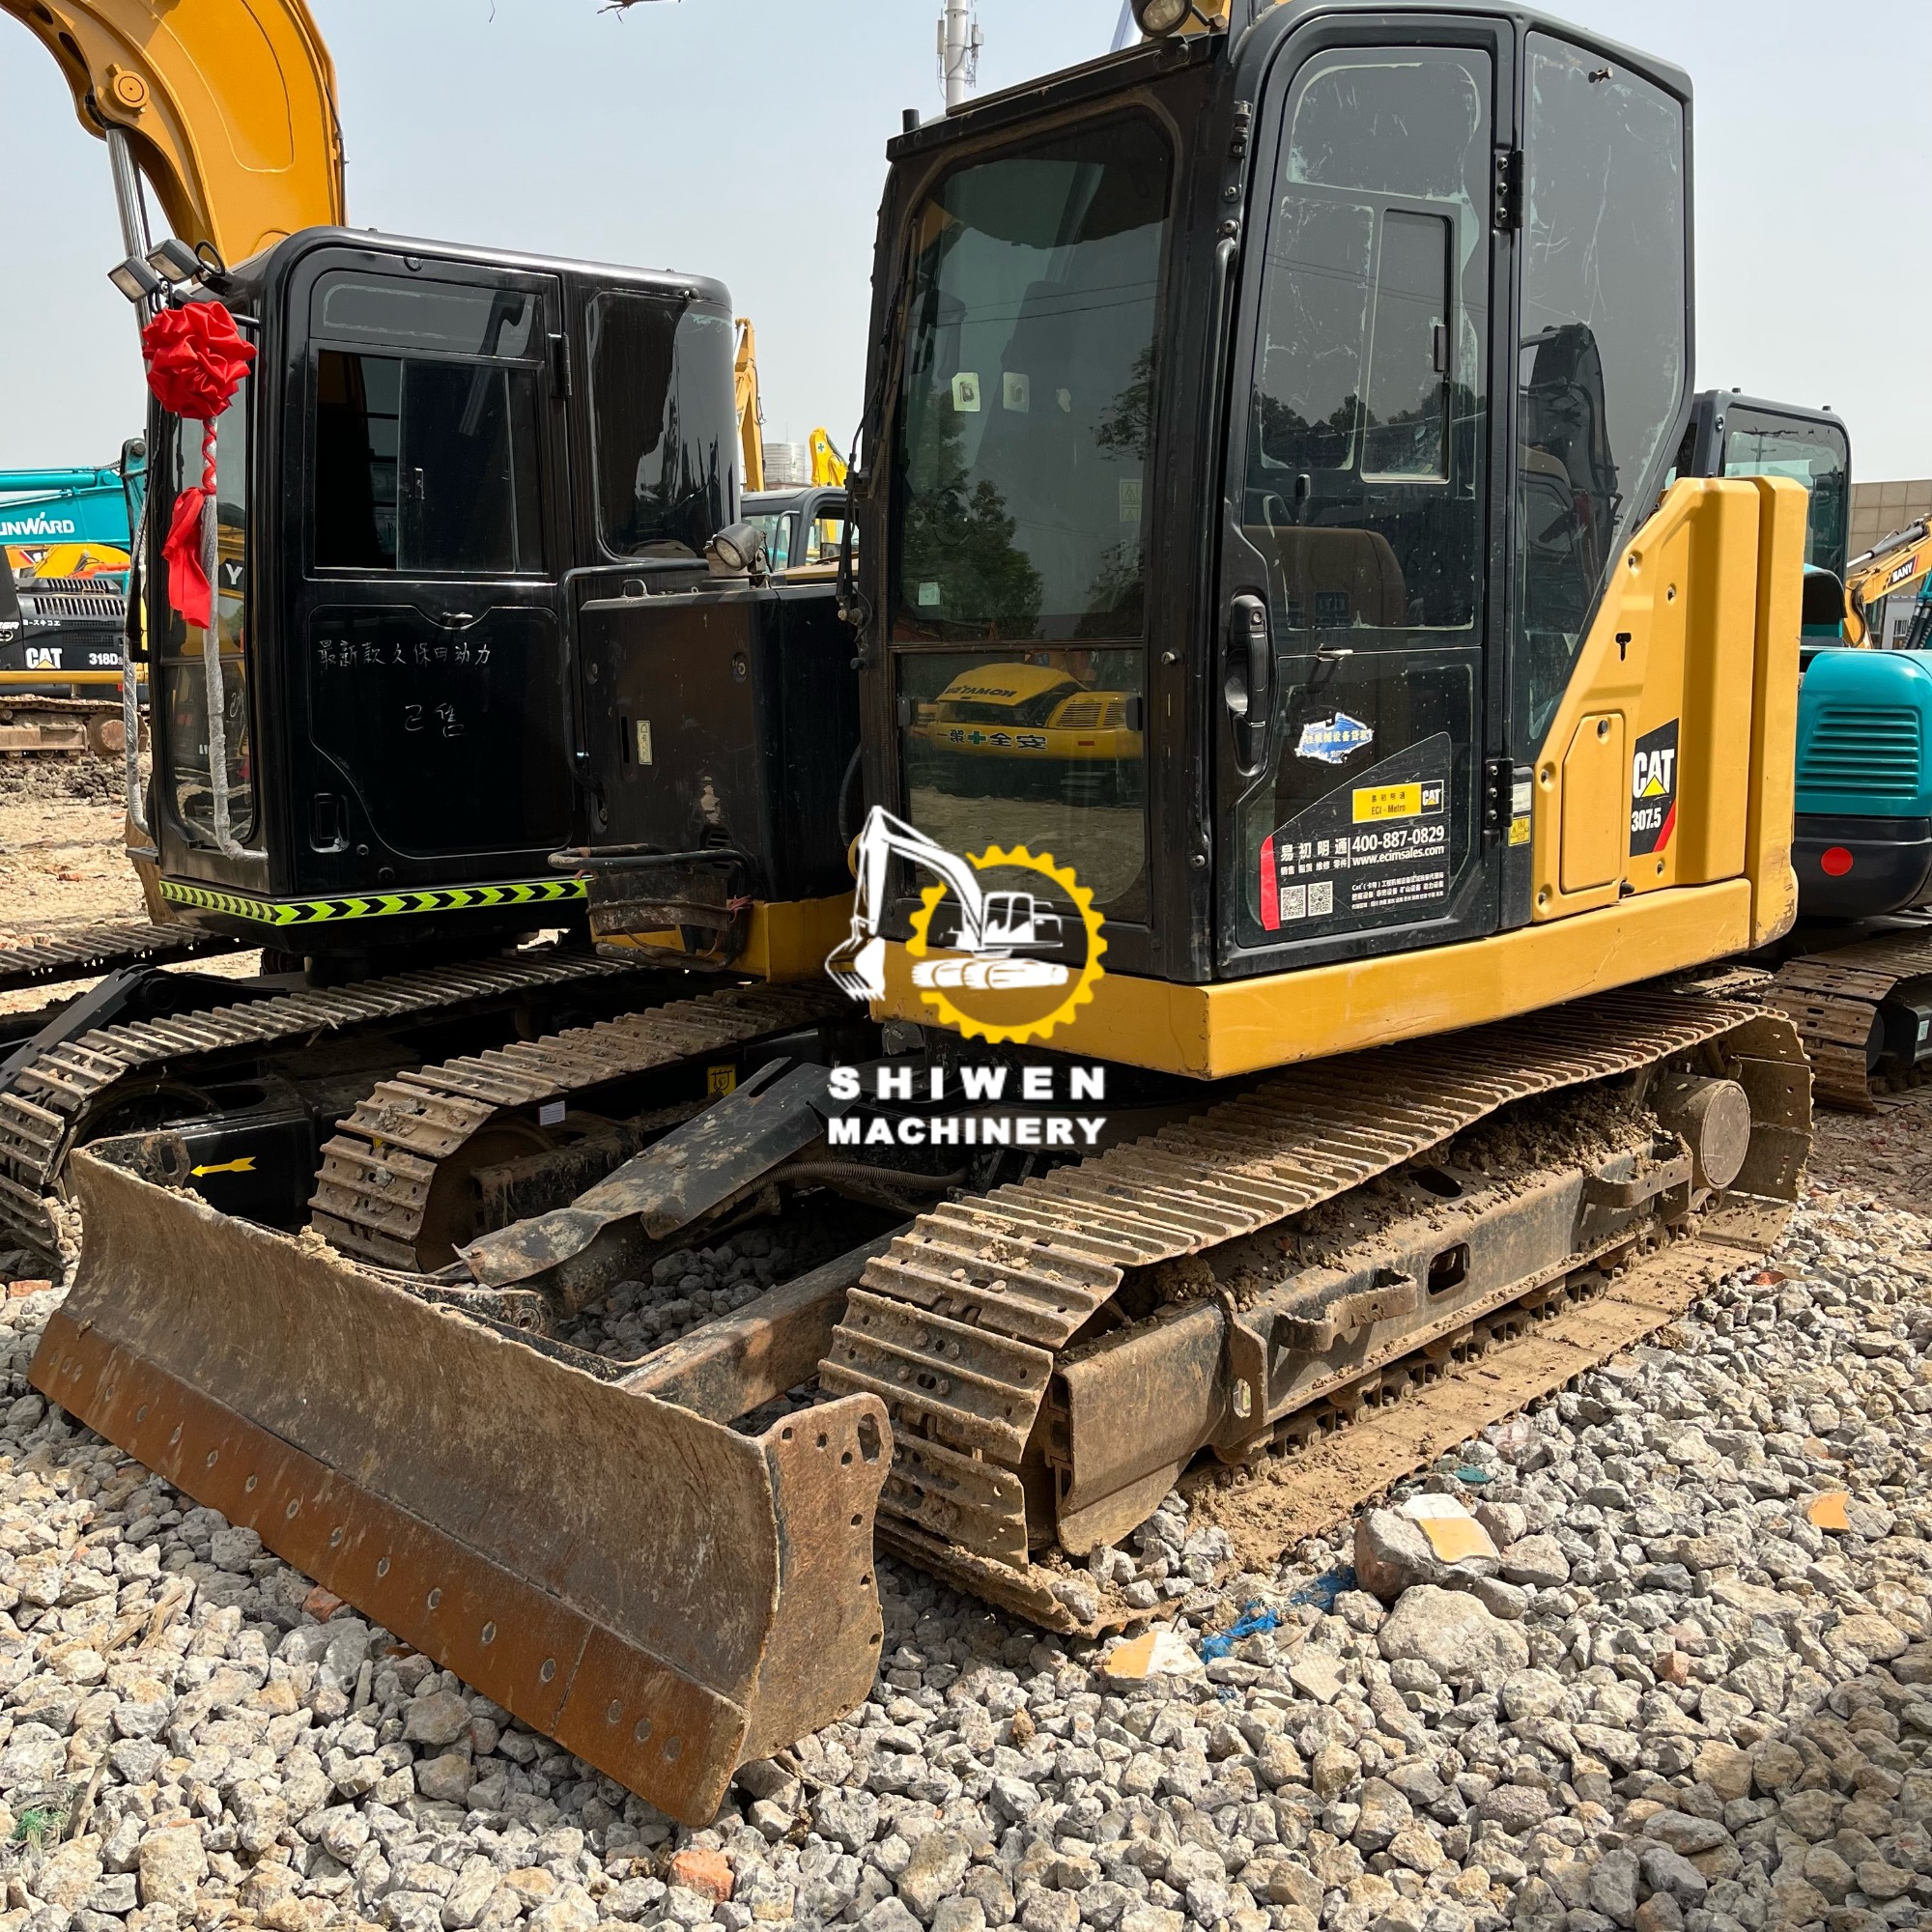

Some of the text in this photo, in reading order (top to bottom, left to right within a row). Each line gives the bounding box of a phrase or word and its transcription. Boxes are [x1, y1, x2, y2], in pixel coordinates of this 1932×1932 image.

[1892, 561, 1914, 582] SANY
[25, 647, 63, 669] CAT
[1633, 748, 1675, 798] CAT
[1422, 788, 1441, 806] CAT
[1388, 804, 1406, 813] Metro
[1631, 807, 1662, 832] 307.5
[1280, 837, 1348, 862] 易初明通
[1352, 825, 1445, 853] 400-887-0829
[1352, 845, 1445, 867] www.ecimsales.com
